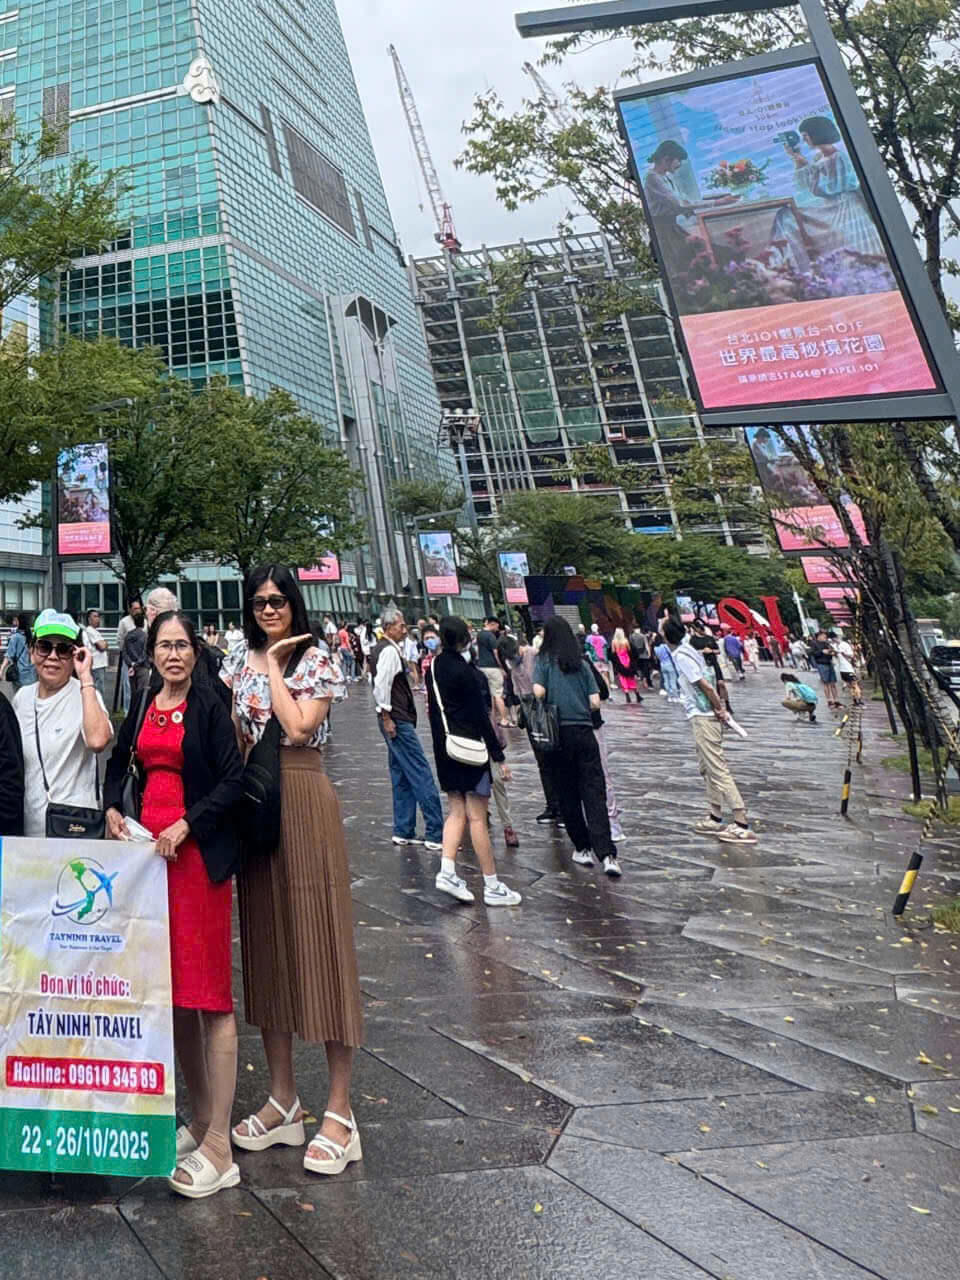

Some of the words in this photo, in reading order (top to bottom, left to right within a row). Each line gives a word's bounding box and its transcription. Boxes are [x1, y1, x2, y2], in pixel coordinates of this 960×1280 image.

[90, 934, 123, 943] TRAVEL
[40, 974, 63, 994] Đơn
[67, 976, 78, 999] vị
[81, 971, 94, 996] tổ
[96, 976, 130, 997] chức:
[28, 1009, 53, 1035] TÂY
[56, 1014, 91, 1036] NINH
[95, 1016, 143, 1039] TRAVEL
[13, 1061, 66, 1084] Hotline:
[69, 1064, 110, 1086] 09610
[113, 1067, 137, 1088] 345
[141, 1068, 158, 1089] 89
[21, 1125, 42, 1154] 22
[56, 1125, 150, 1160] 26/10/2025
